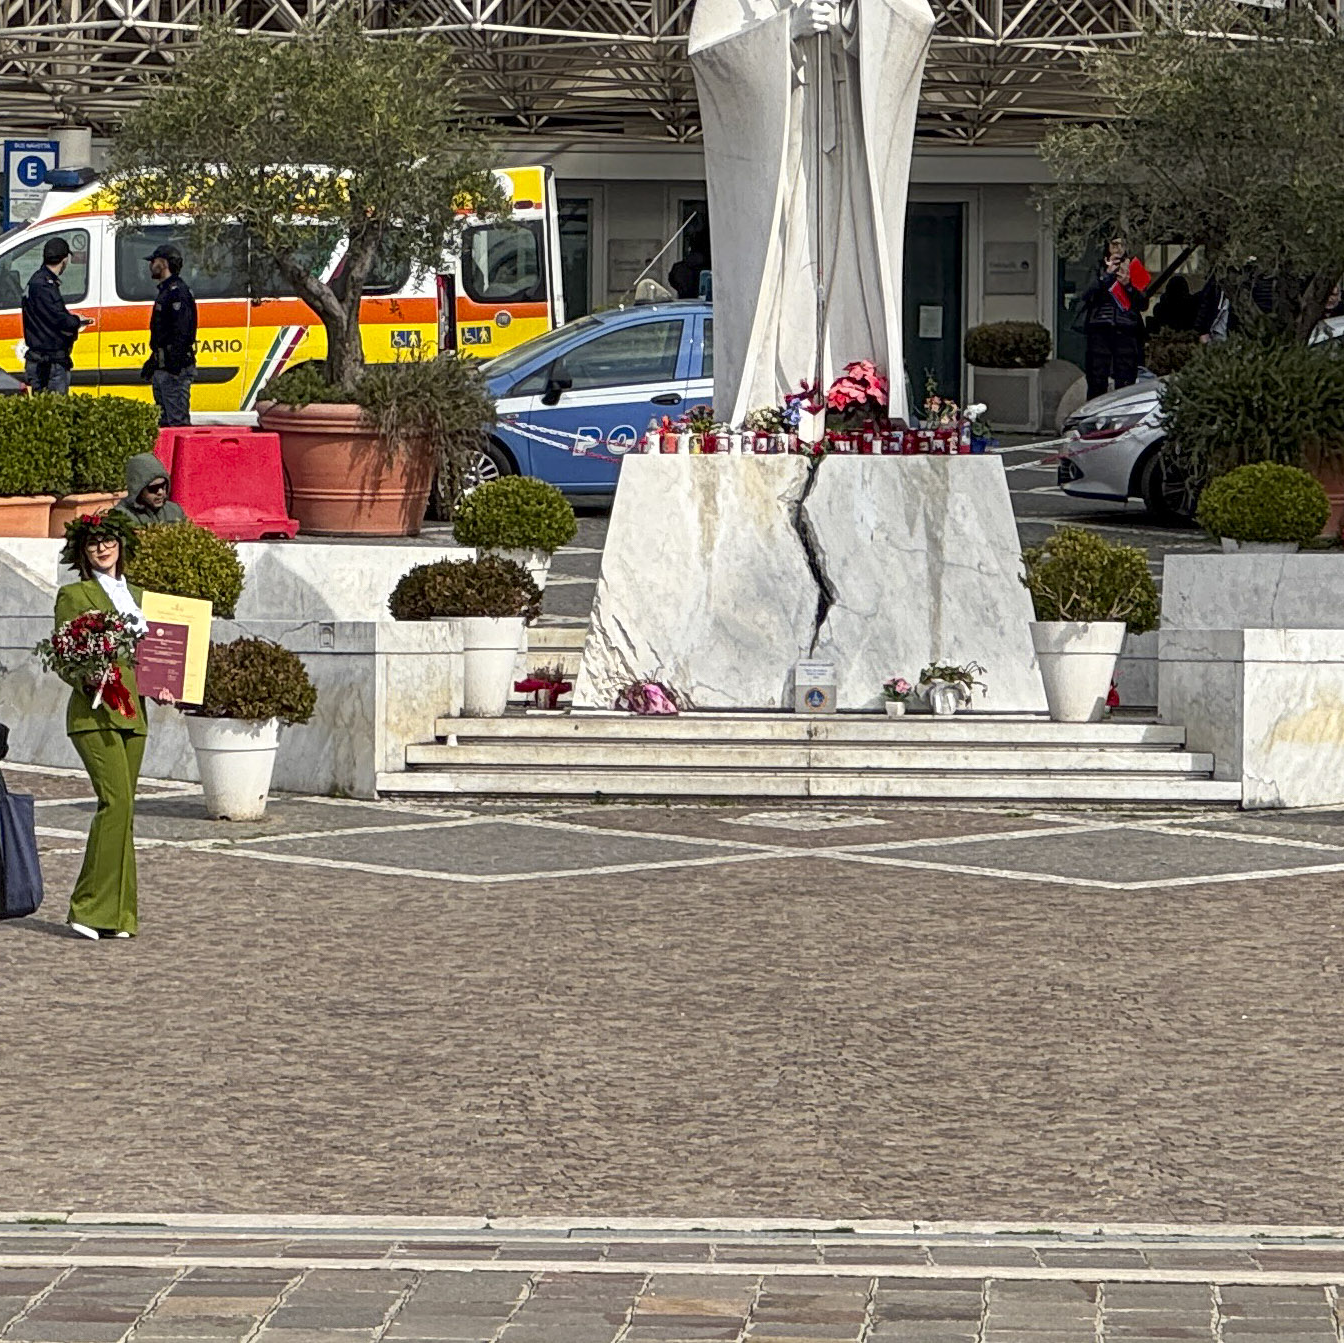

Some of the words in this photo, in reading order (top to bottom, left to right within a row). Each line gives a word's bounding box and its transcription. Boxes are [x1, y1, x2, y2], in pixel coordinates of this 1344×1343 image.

[27, 163, 37, 179] E
[108, 342, 146, 357] TAXI
[192, 339, 242, 355] TARIO
